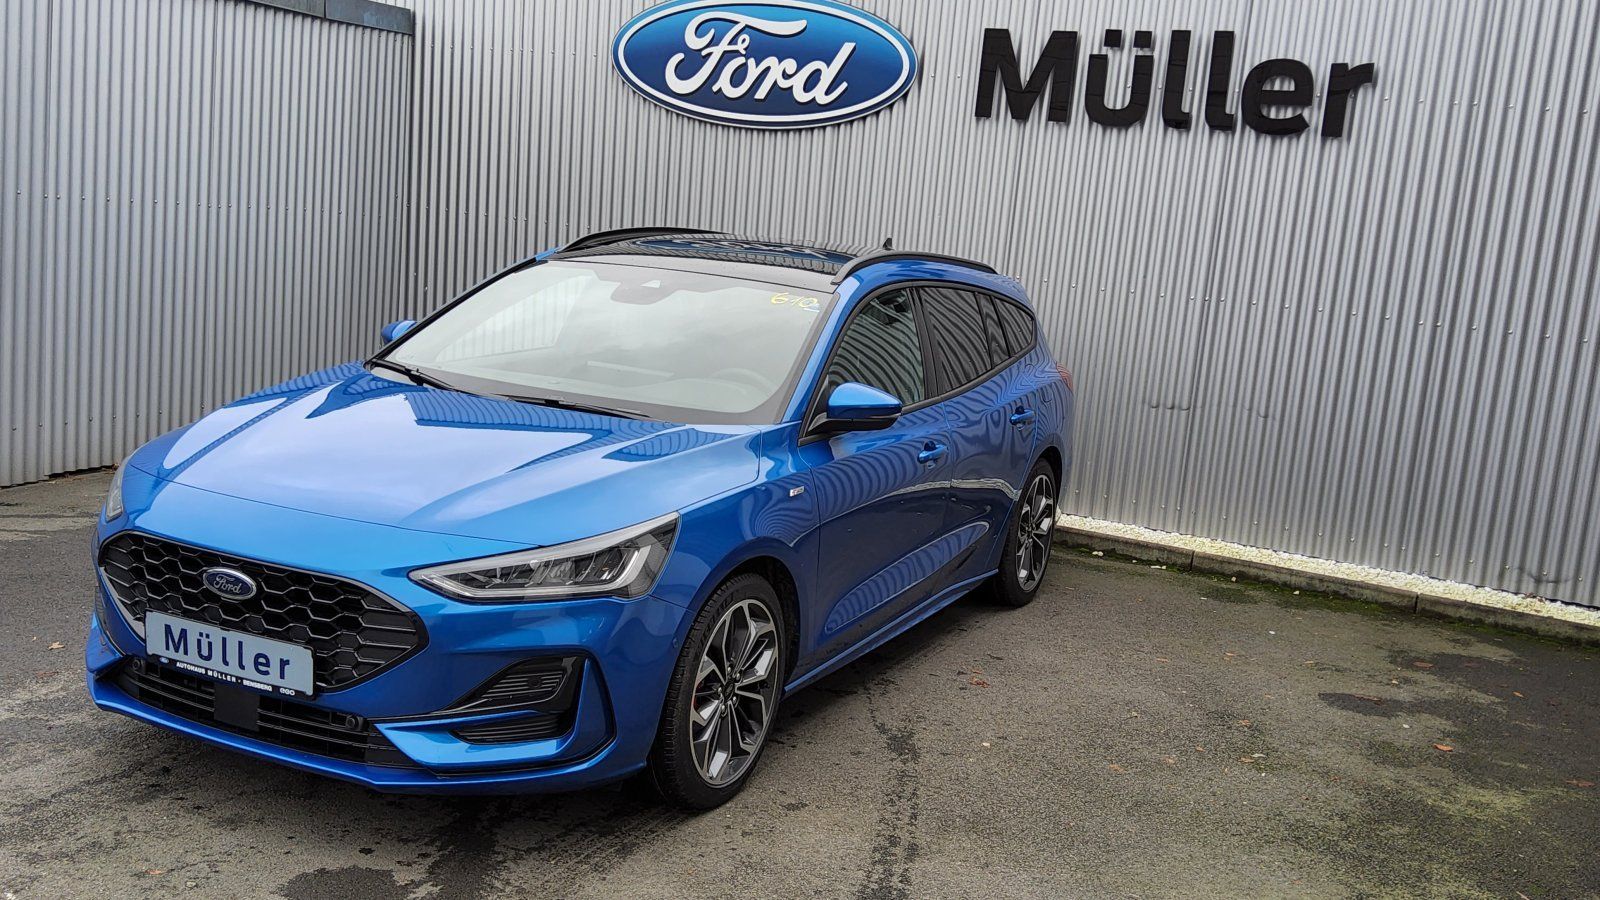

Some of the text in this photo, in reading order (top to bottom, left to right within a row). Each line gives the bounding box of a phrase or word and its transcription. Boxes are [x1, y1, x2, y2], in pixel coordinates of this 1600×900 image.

[665, 11, 856, 104] Ford
[974, 27, 1375, 138] Müller
[213, 574, 242, 593] Ford
[164, 623, 291, 680] Müller
[176, 661, 206, 675] AUTOHAUS
[207, 669, 236, 683] MÜLLER
